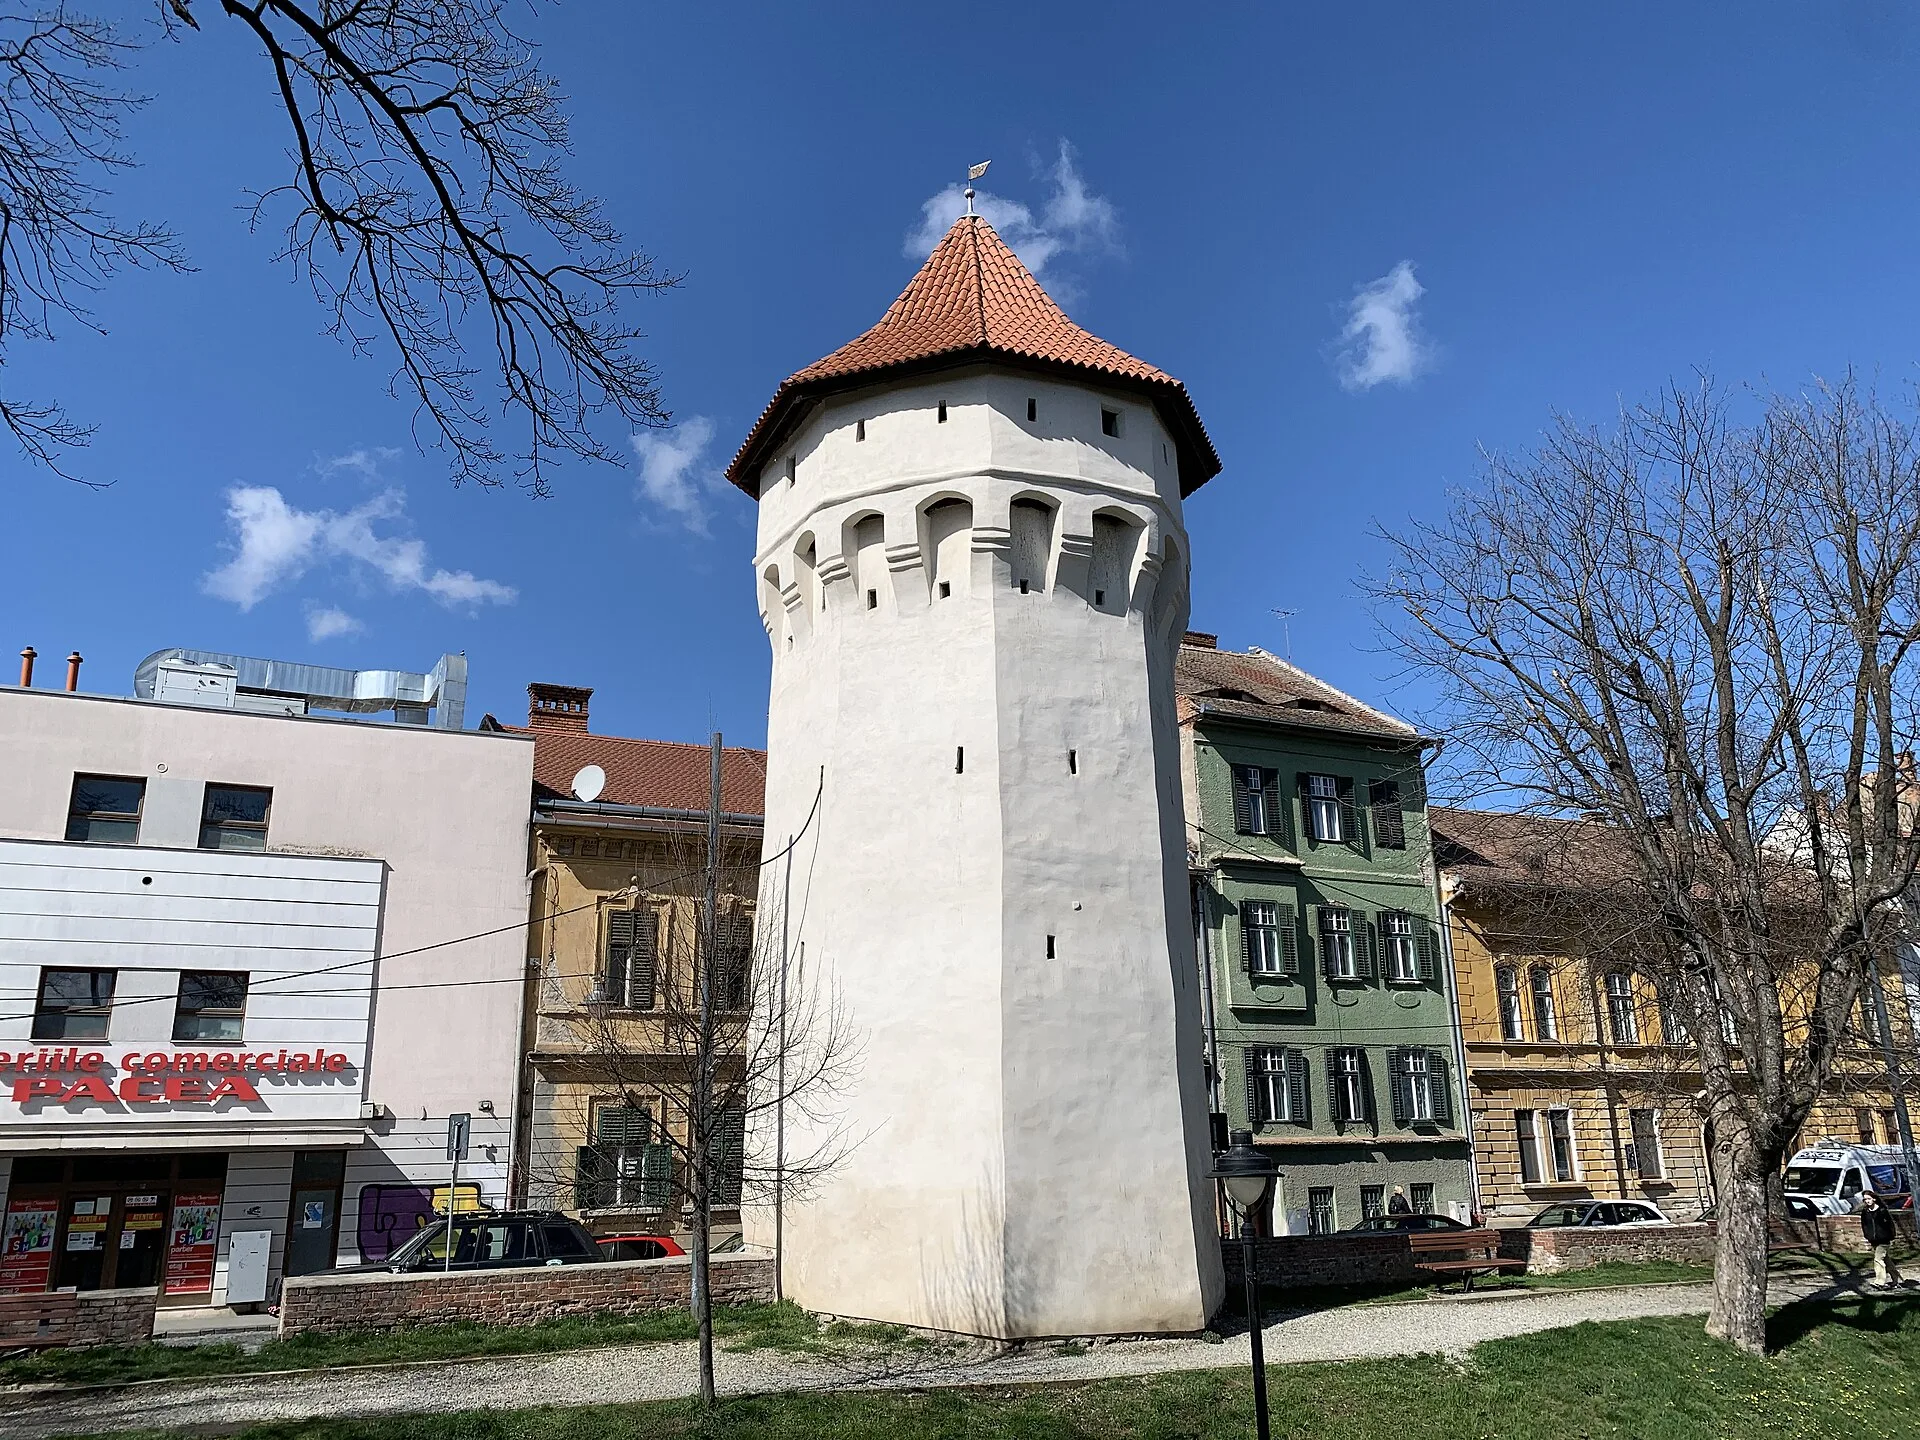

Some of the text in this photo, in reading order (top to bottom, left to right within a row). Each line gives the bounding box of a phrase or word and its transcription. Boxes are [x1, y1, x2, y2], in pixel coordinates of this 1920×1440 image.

[121, 1049, 347, 1072] comerciale
[11, 1077, 261, 1102] PACEA
[12, 1235, 49, 1252] SHOP
[179, 1228, 212, 1244] SHOP
